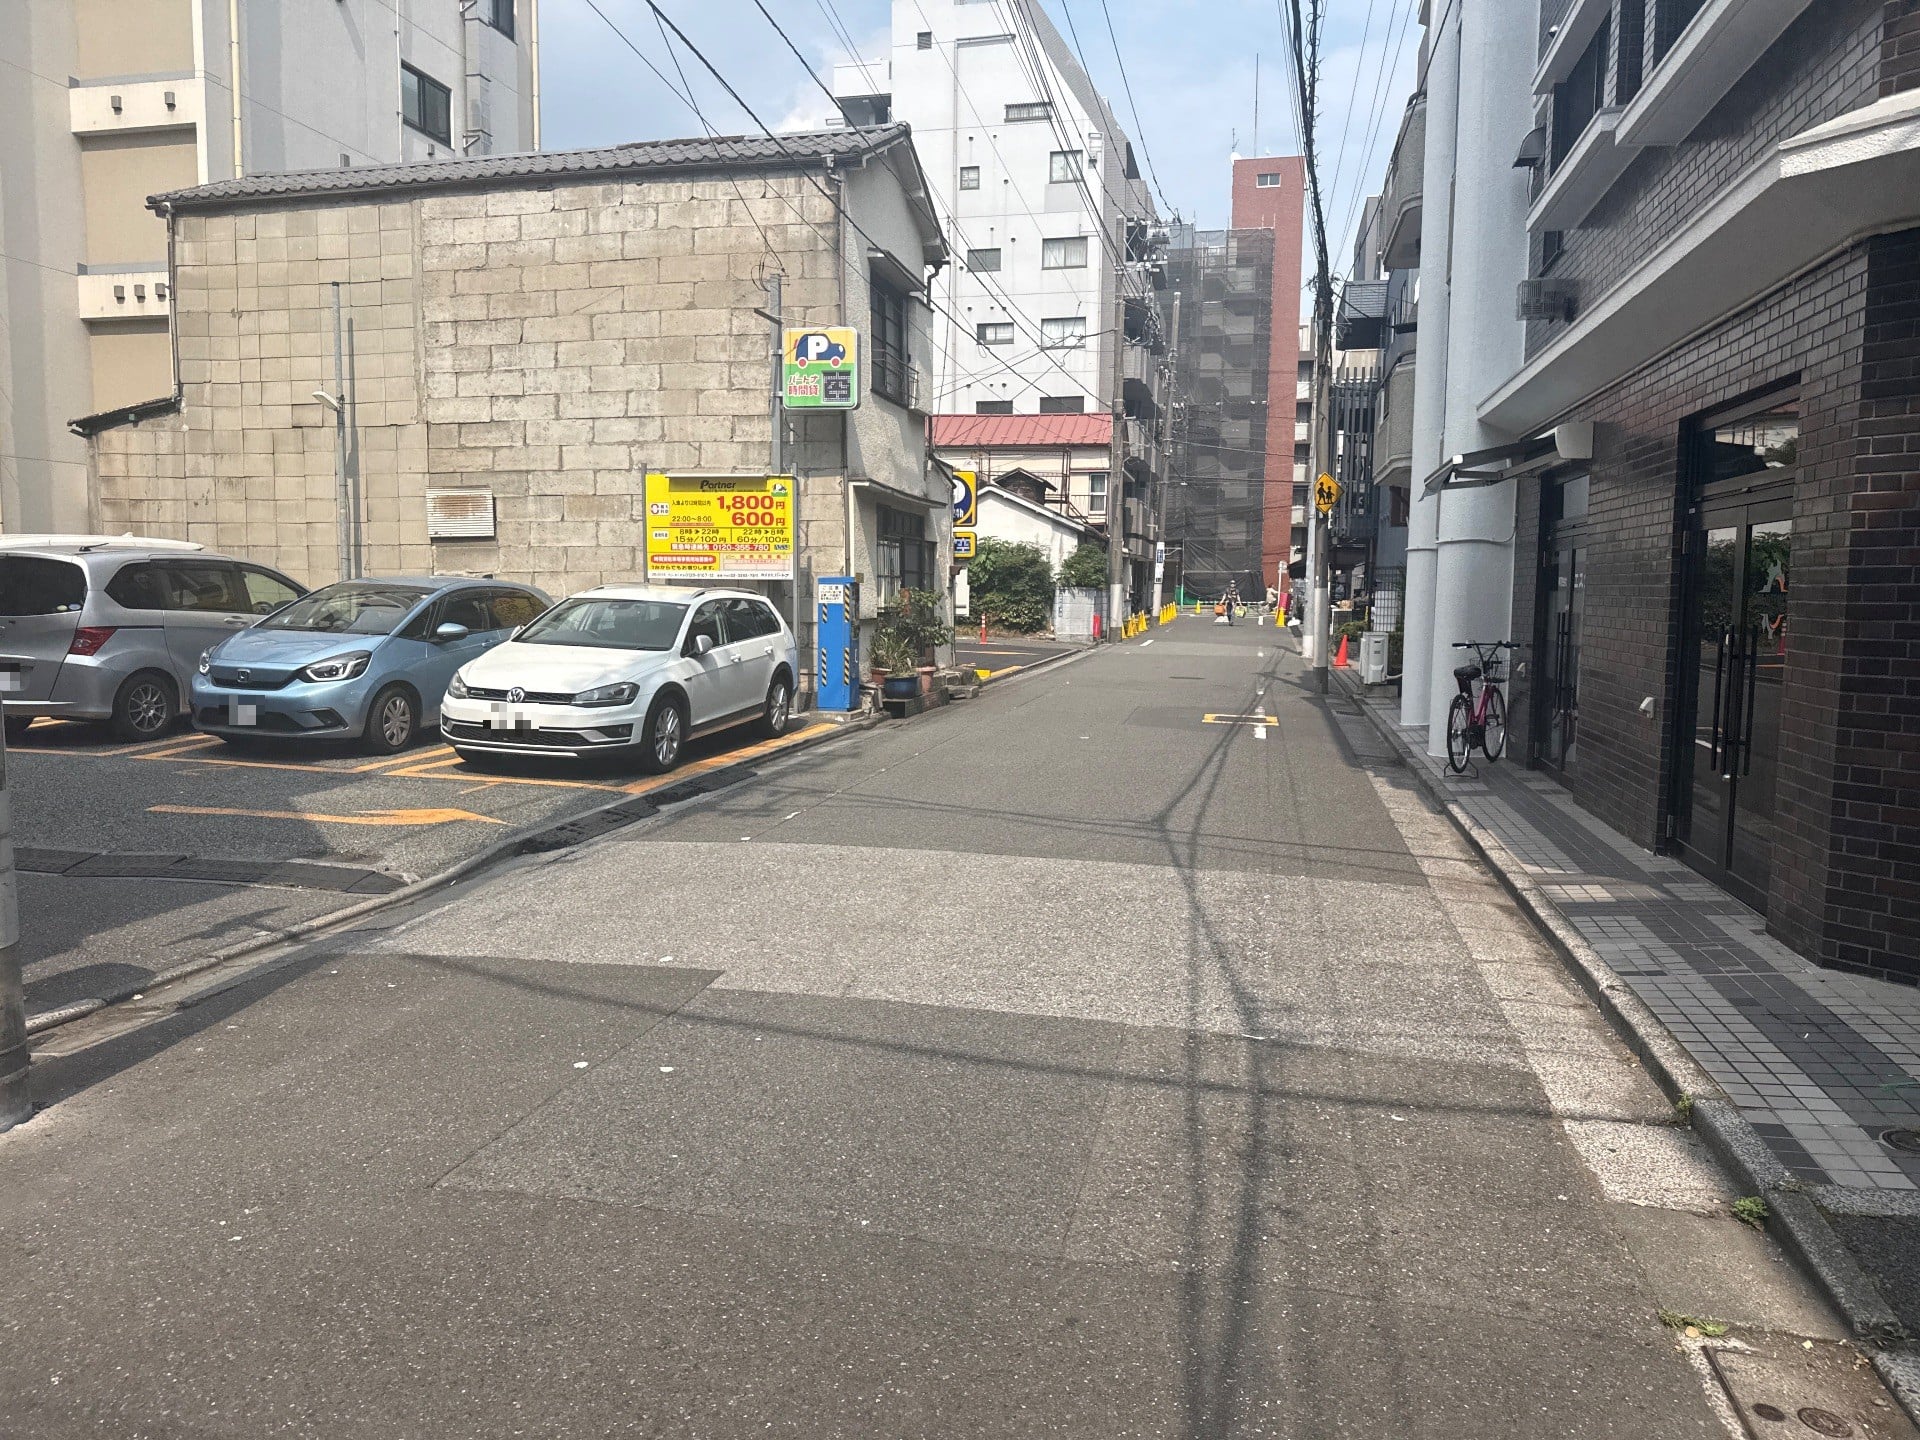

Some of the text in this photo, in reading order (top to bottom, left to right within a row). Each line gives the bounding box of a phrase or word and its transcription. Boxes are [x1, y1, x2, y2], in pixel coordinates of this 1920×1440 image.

[788, 385, 818, 396] 時間貸
[700, 480, 736, 489] Partner
[717, 495, 785, 512] 1,800円
[732, 511, 785, 527] 600円
